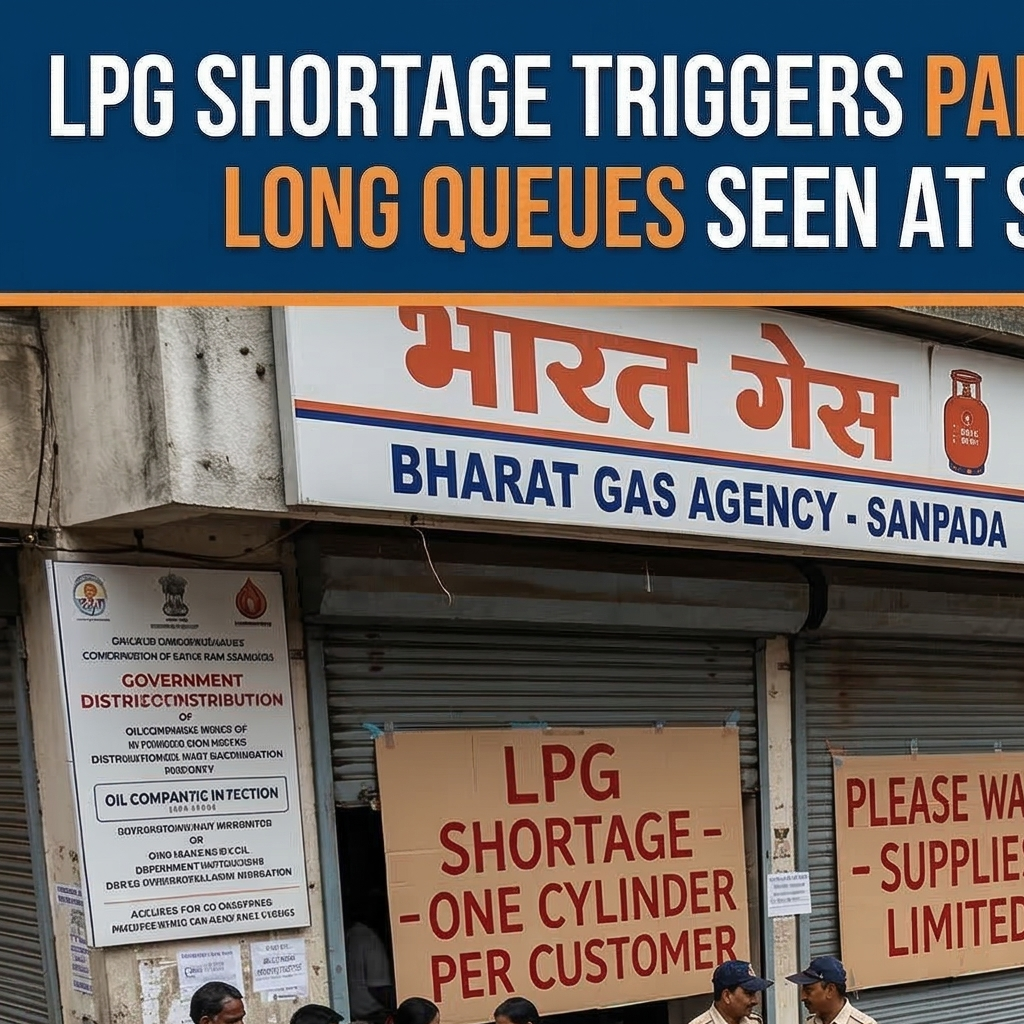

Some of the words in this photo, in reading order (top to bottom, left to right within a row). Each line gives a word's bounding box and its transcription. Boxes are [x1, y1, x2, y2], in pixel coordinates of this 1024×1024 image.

[398, 306, 698, 434] भारत
[731, 323, 899, 461] गेस
[391, 443, 579, 509] BHARAT
[593, 466, 677, 518] GAS
[688, 476, 838, 532] AGENCY
[867, 492, 1008, 549] SANPADA
[121, 673, 244, 688] GOVERNMENT
[105, 793, 128, 807] OIL
[504, 742, 621, 806] LPG
[847, 774, 969, 828] PLEASE
[189, 835, 204, 845] OR
[439, 810, 694, 876] SHORTAGE
[180, 904, 201, 914] FOR
[538, 869, 737, 930] CYLINDER
[431, 949, 515, 1003] PER
[528, 925, 737, 991] CUSTOMER
